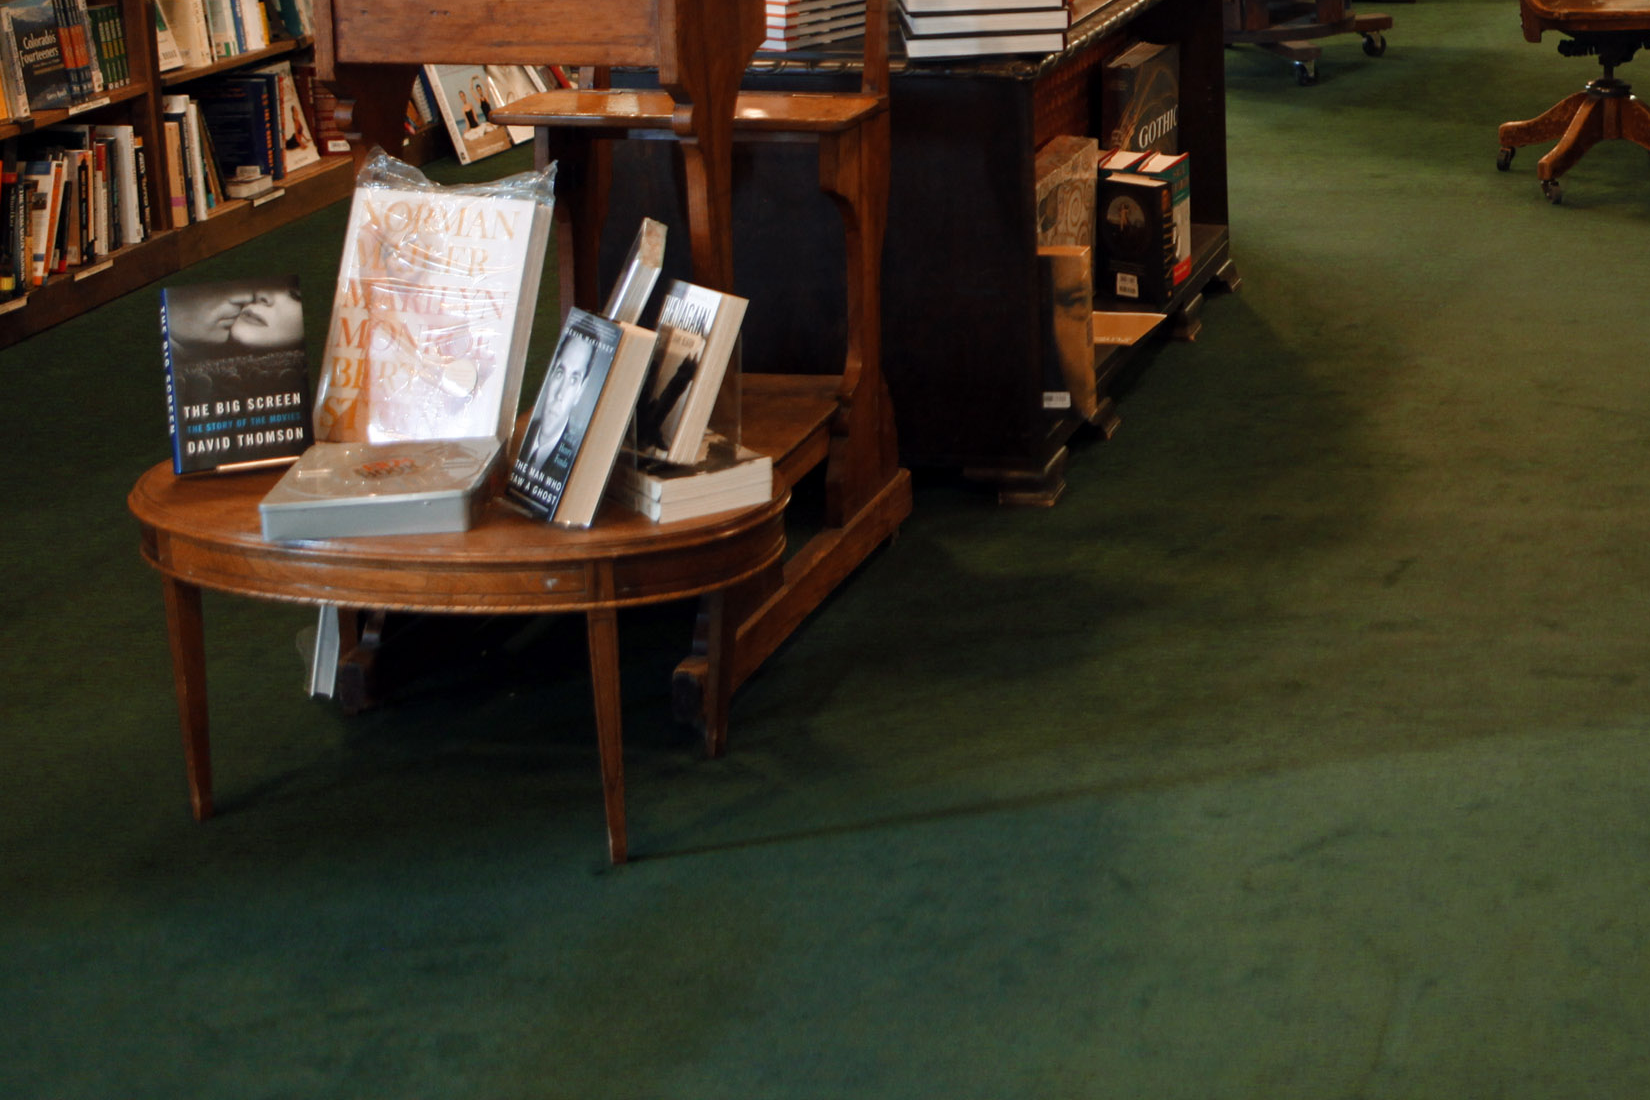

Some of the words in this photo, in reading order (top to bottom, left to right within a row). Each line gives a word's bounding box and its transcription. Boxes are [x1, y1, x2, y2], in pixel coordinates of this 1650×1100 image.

[23, 30, 57, 50] Colorado's
[19, 47, 59, 68] Fourteeners
[363, 188, 521, 241] NORMAN
[342, 277, 511, 320] MARILYN
[160, 305, 168, 334] THE
[162, 341, 171, 368] BIG
[166, 374, 176, 436] SCREEN
[184, 404, 210, 420] THE
[216, 399, 240, 415] BIG
[248, 392, 302, 411] SCREEN
[187, 424, 203, 435] THE
[206, 419, 234, 433] STORY
[236, 418, 247, 429] OF
[251, 415, 266, 426] THE
[269, 411, 302, 423] MOVIES
[187, 436, 230, 455] DAVID
[237, 426, 304, 448] THOMSON
[509, 472, 526, 487] SAW
[525, 479, 532, 491] A
[531, 482, 558, 506] GHOST
[514, 459, 529, 473] THE
[529, 464, 546, 481] MAN
[546, 473, 562, 492] WHO
